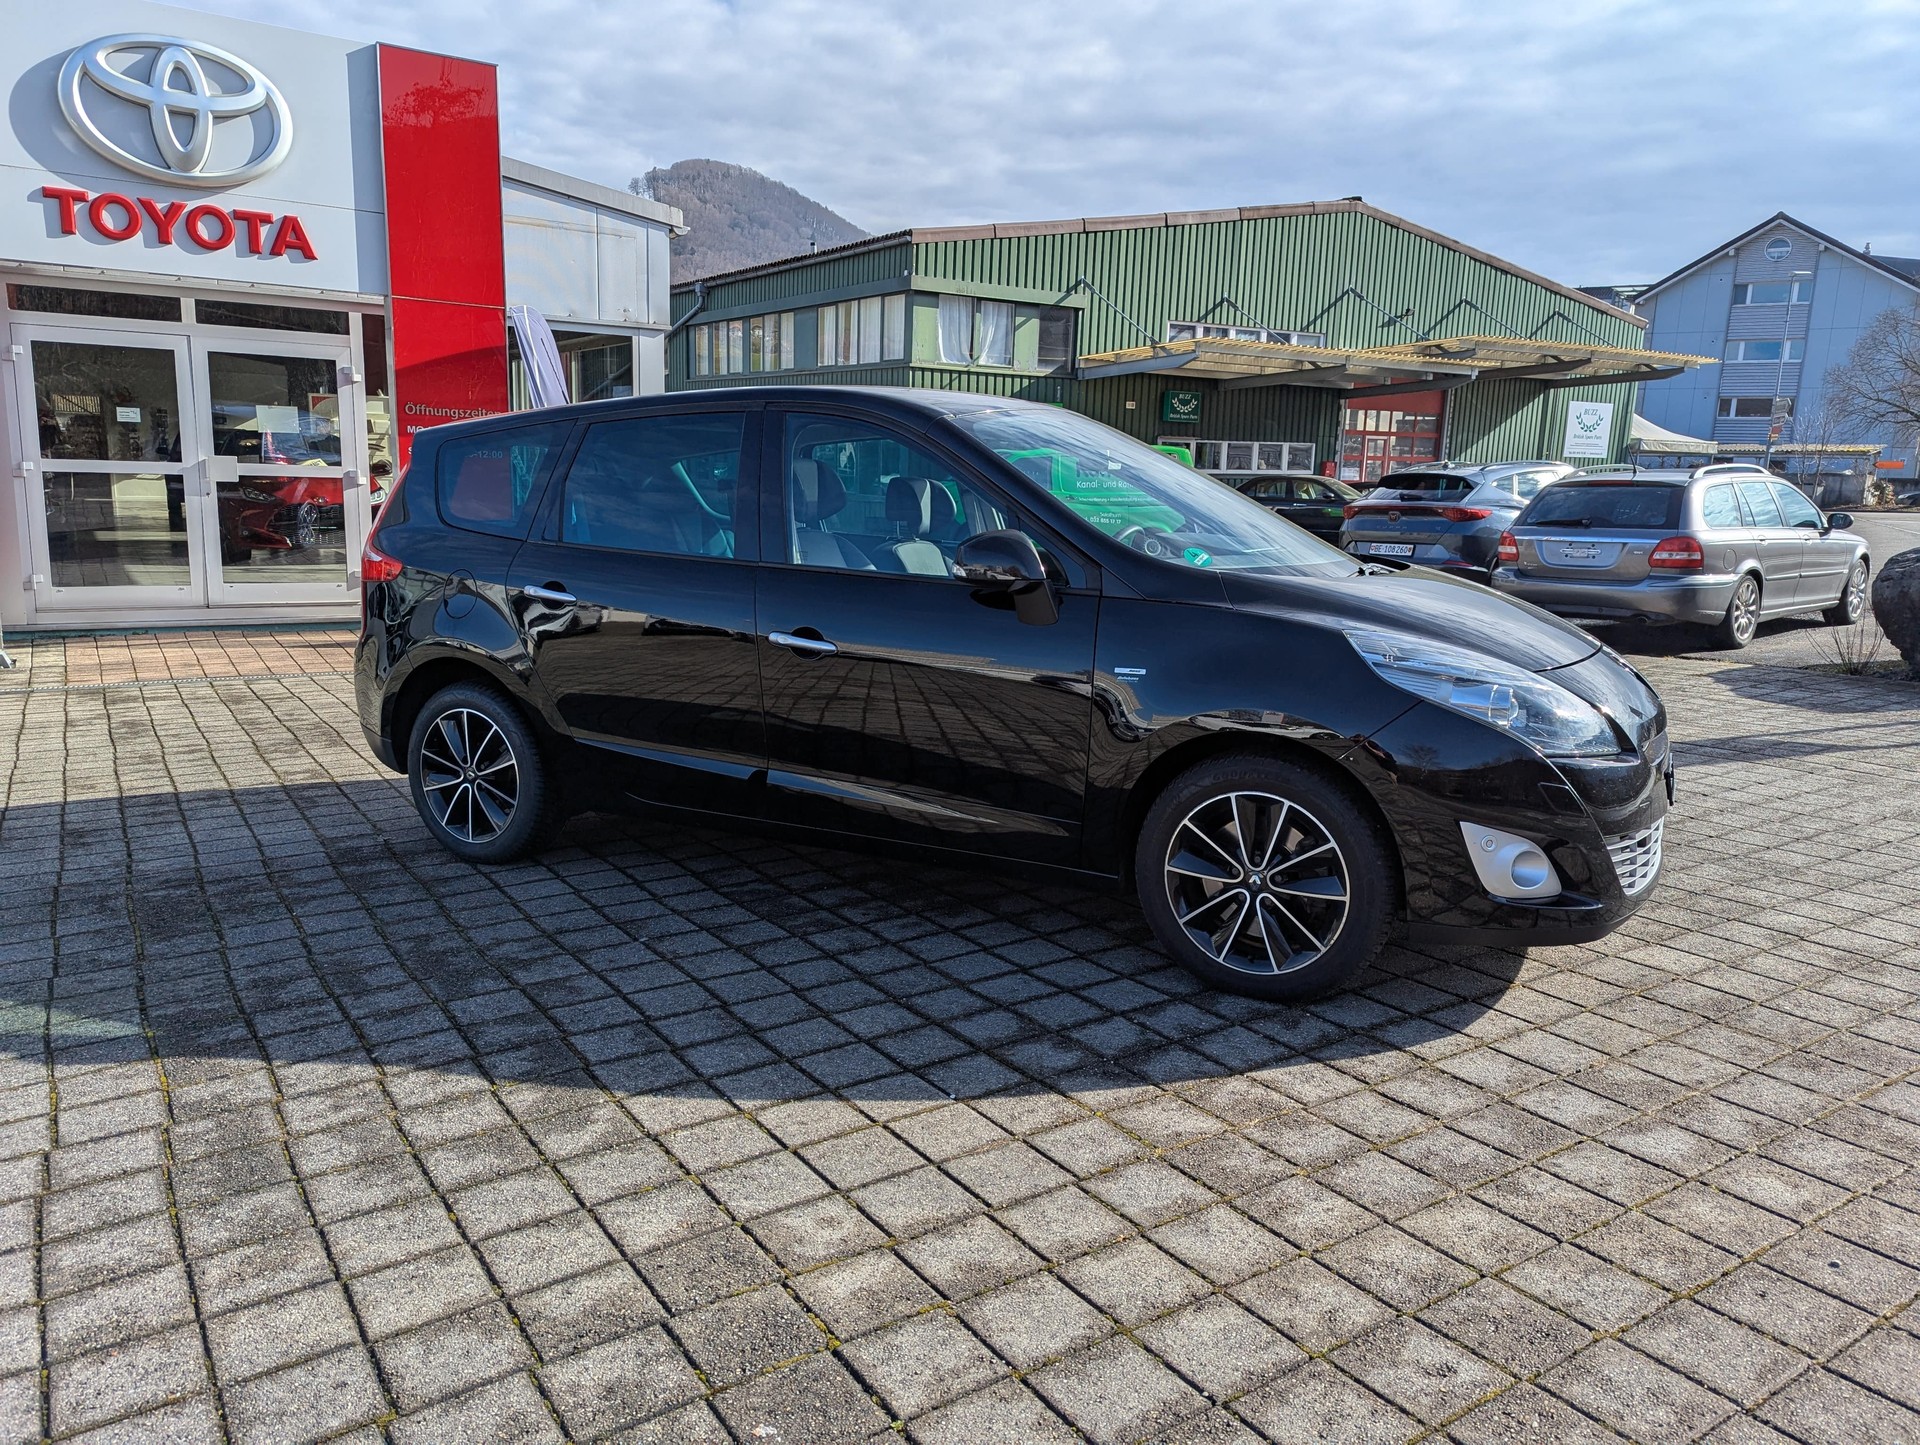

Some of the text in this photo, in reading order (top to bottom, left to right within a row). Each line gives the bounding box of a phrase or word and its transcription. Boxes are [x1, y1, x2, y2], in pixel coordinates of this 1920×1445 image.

[41, 185, 319, 261] TOYOTA
[1583, 408, 1599, 416] BUZZ
[1076, 479, 1101, 489] Kanal-
[1102, 480, 1117, 488] und
